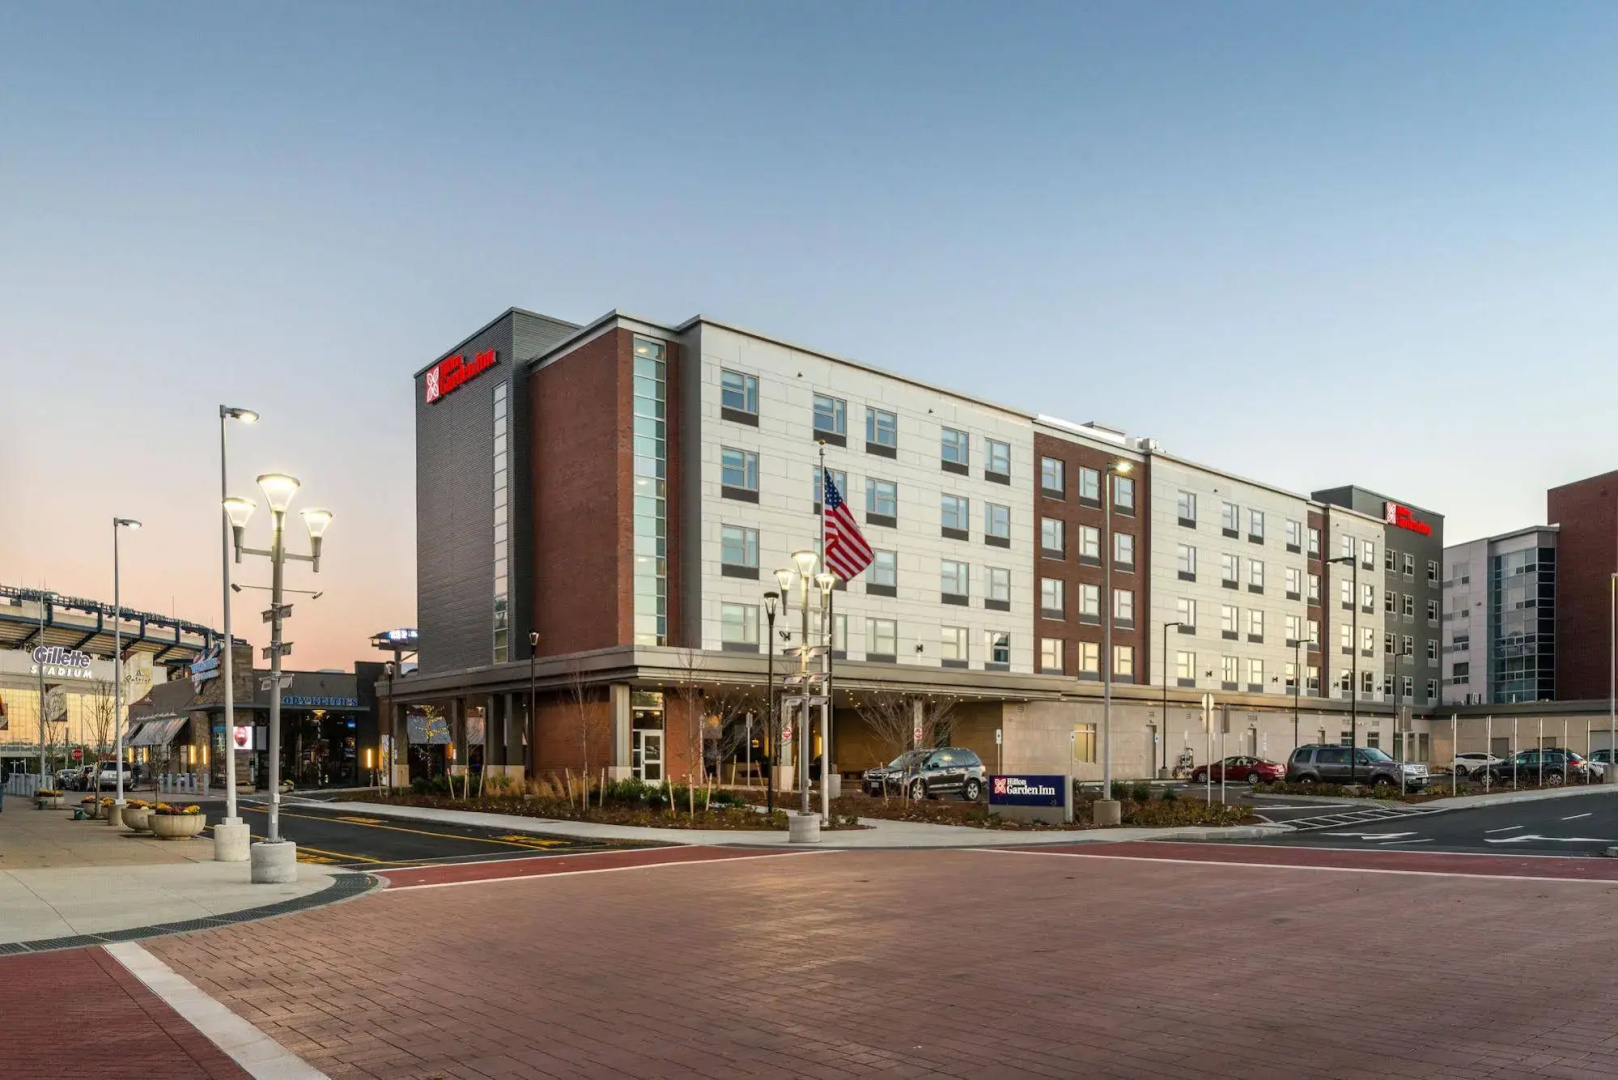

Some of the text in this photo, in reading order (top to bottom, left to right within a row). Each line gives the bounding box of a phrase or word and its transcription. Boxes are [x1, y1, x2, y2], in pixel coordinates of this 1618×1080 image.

[33, 645, 91, 669] Gillette
[30, 665, 92, 679] STADIUM
[1007, 777, 1027, 786] Hilton
[1006, 785, 1056, 795] Garden Inn
